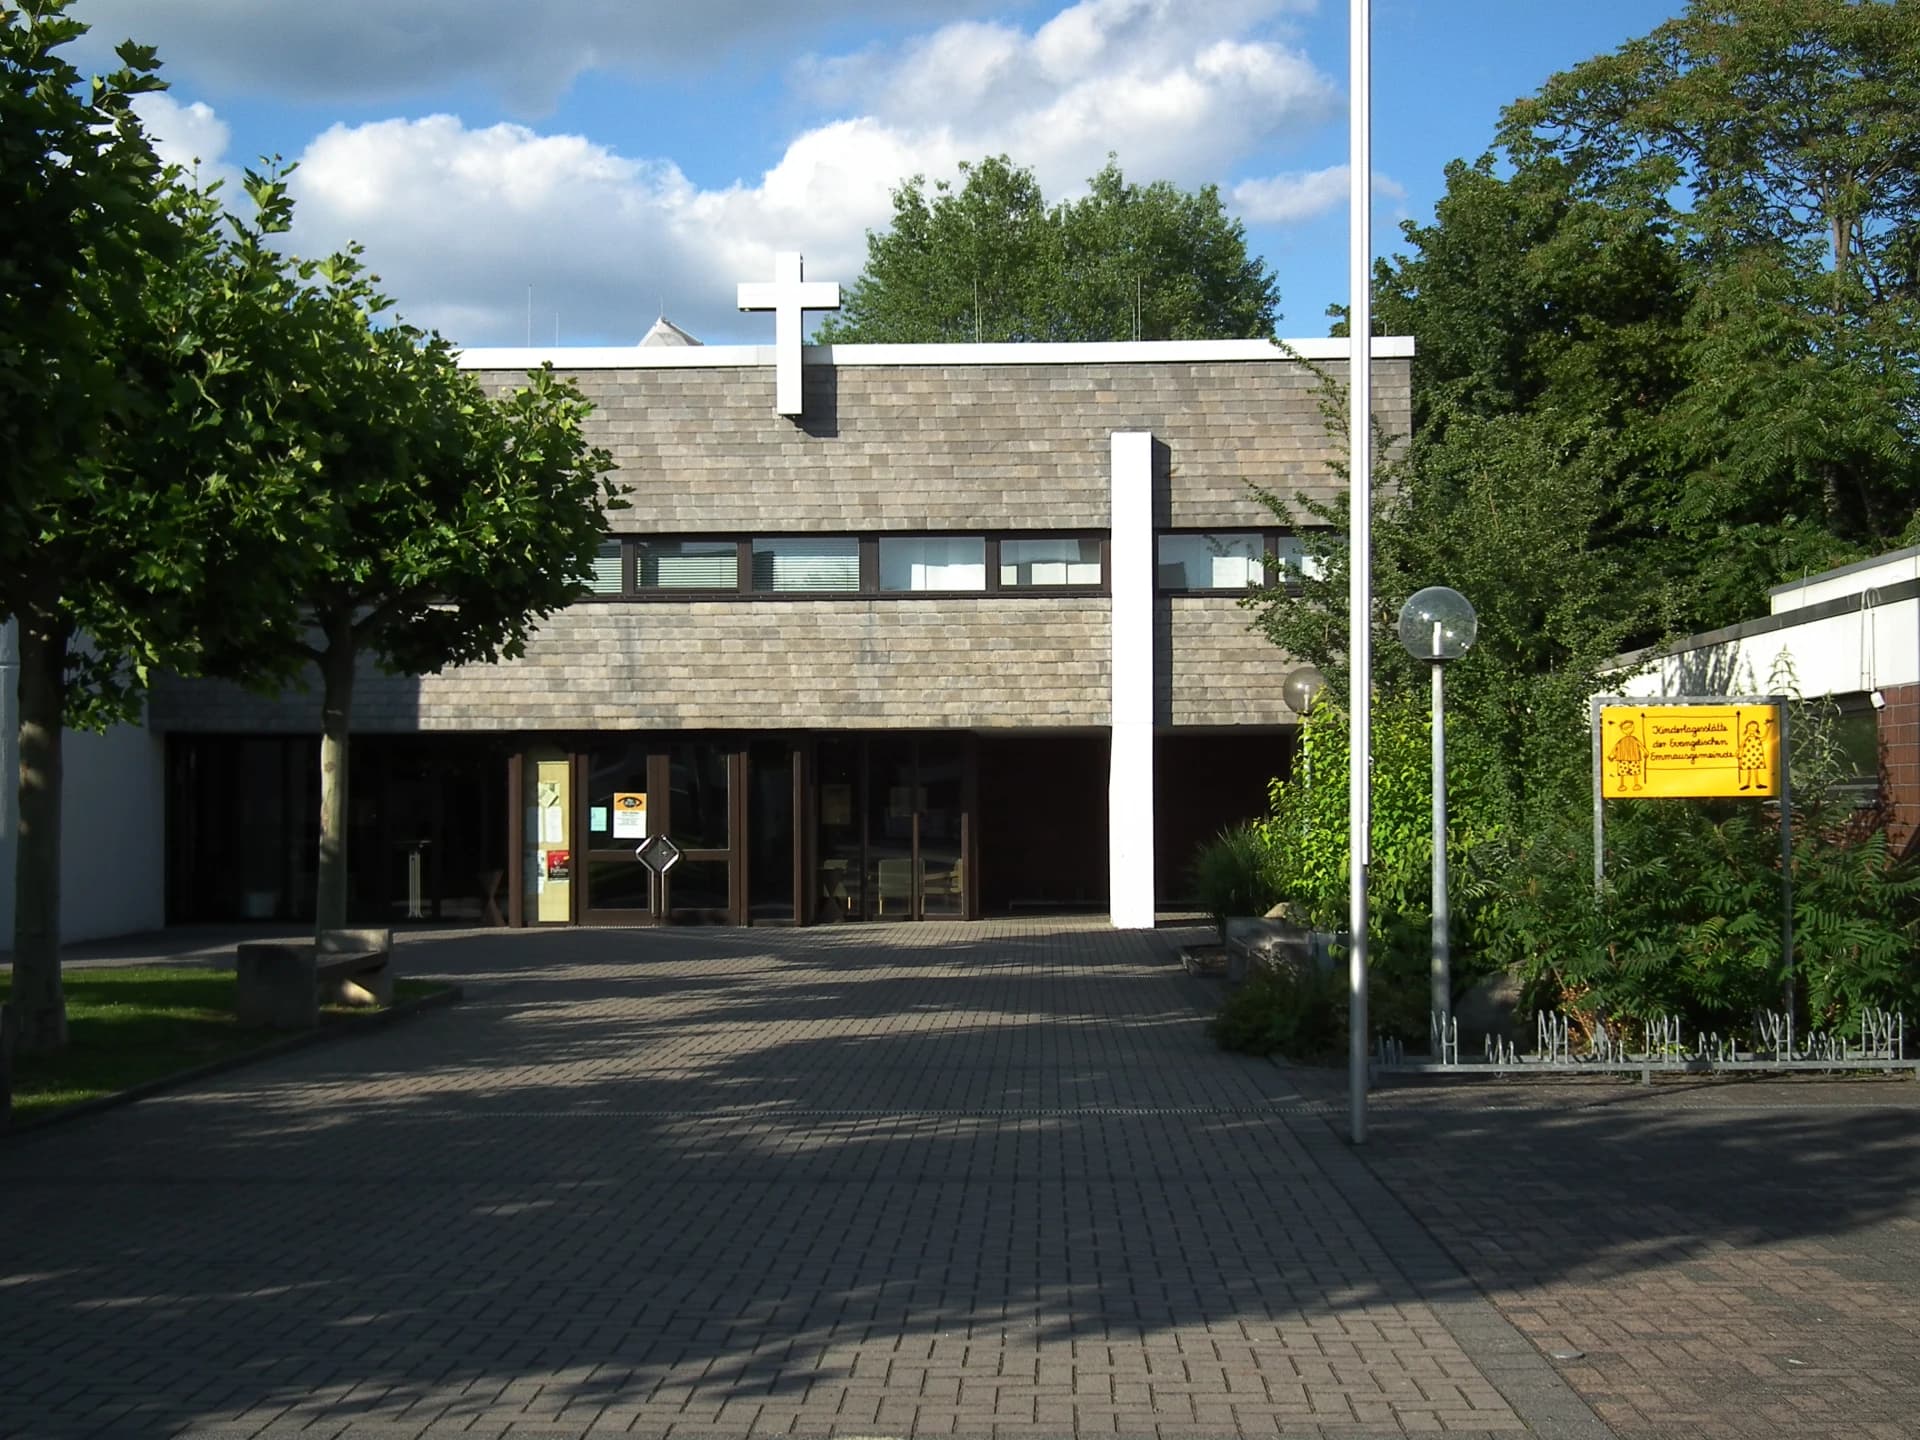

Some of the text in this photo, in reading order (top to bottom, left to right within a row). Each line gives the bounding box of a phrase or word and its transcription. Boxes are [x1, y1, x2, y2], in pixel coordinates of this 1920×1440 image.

[1652, 723, 1728, 737] Kindertagesstätte
[1652, 737, 1728, 751] der Evangelischen
[1650, 751, 1734, 765] Emmausgemeinde
